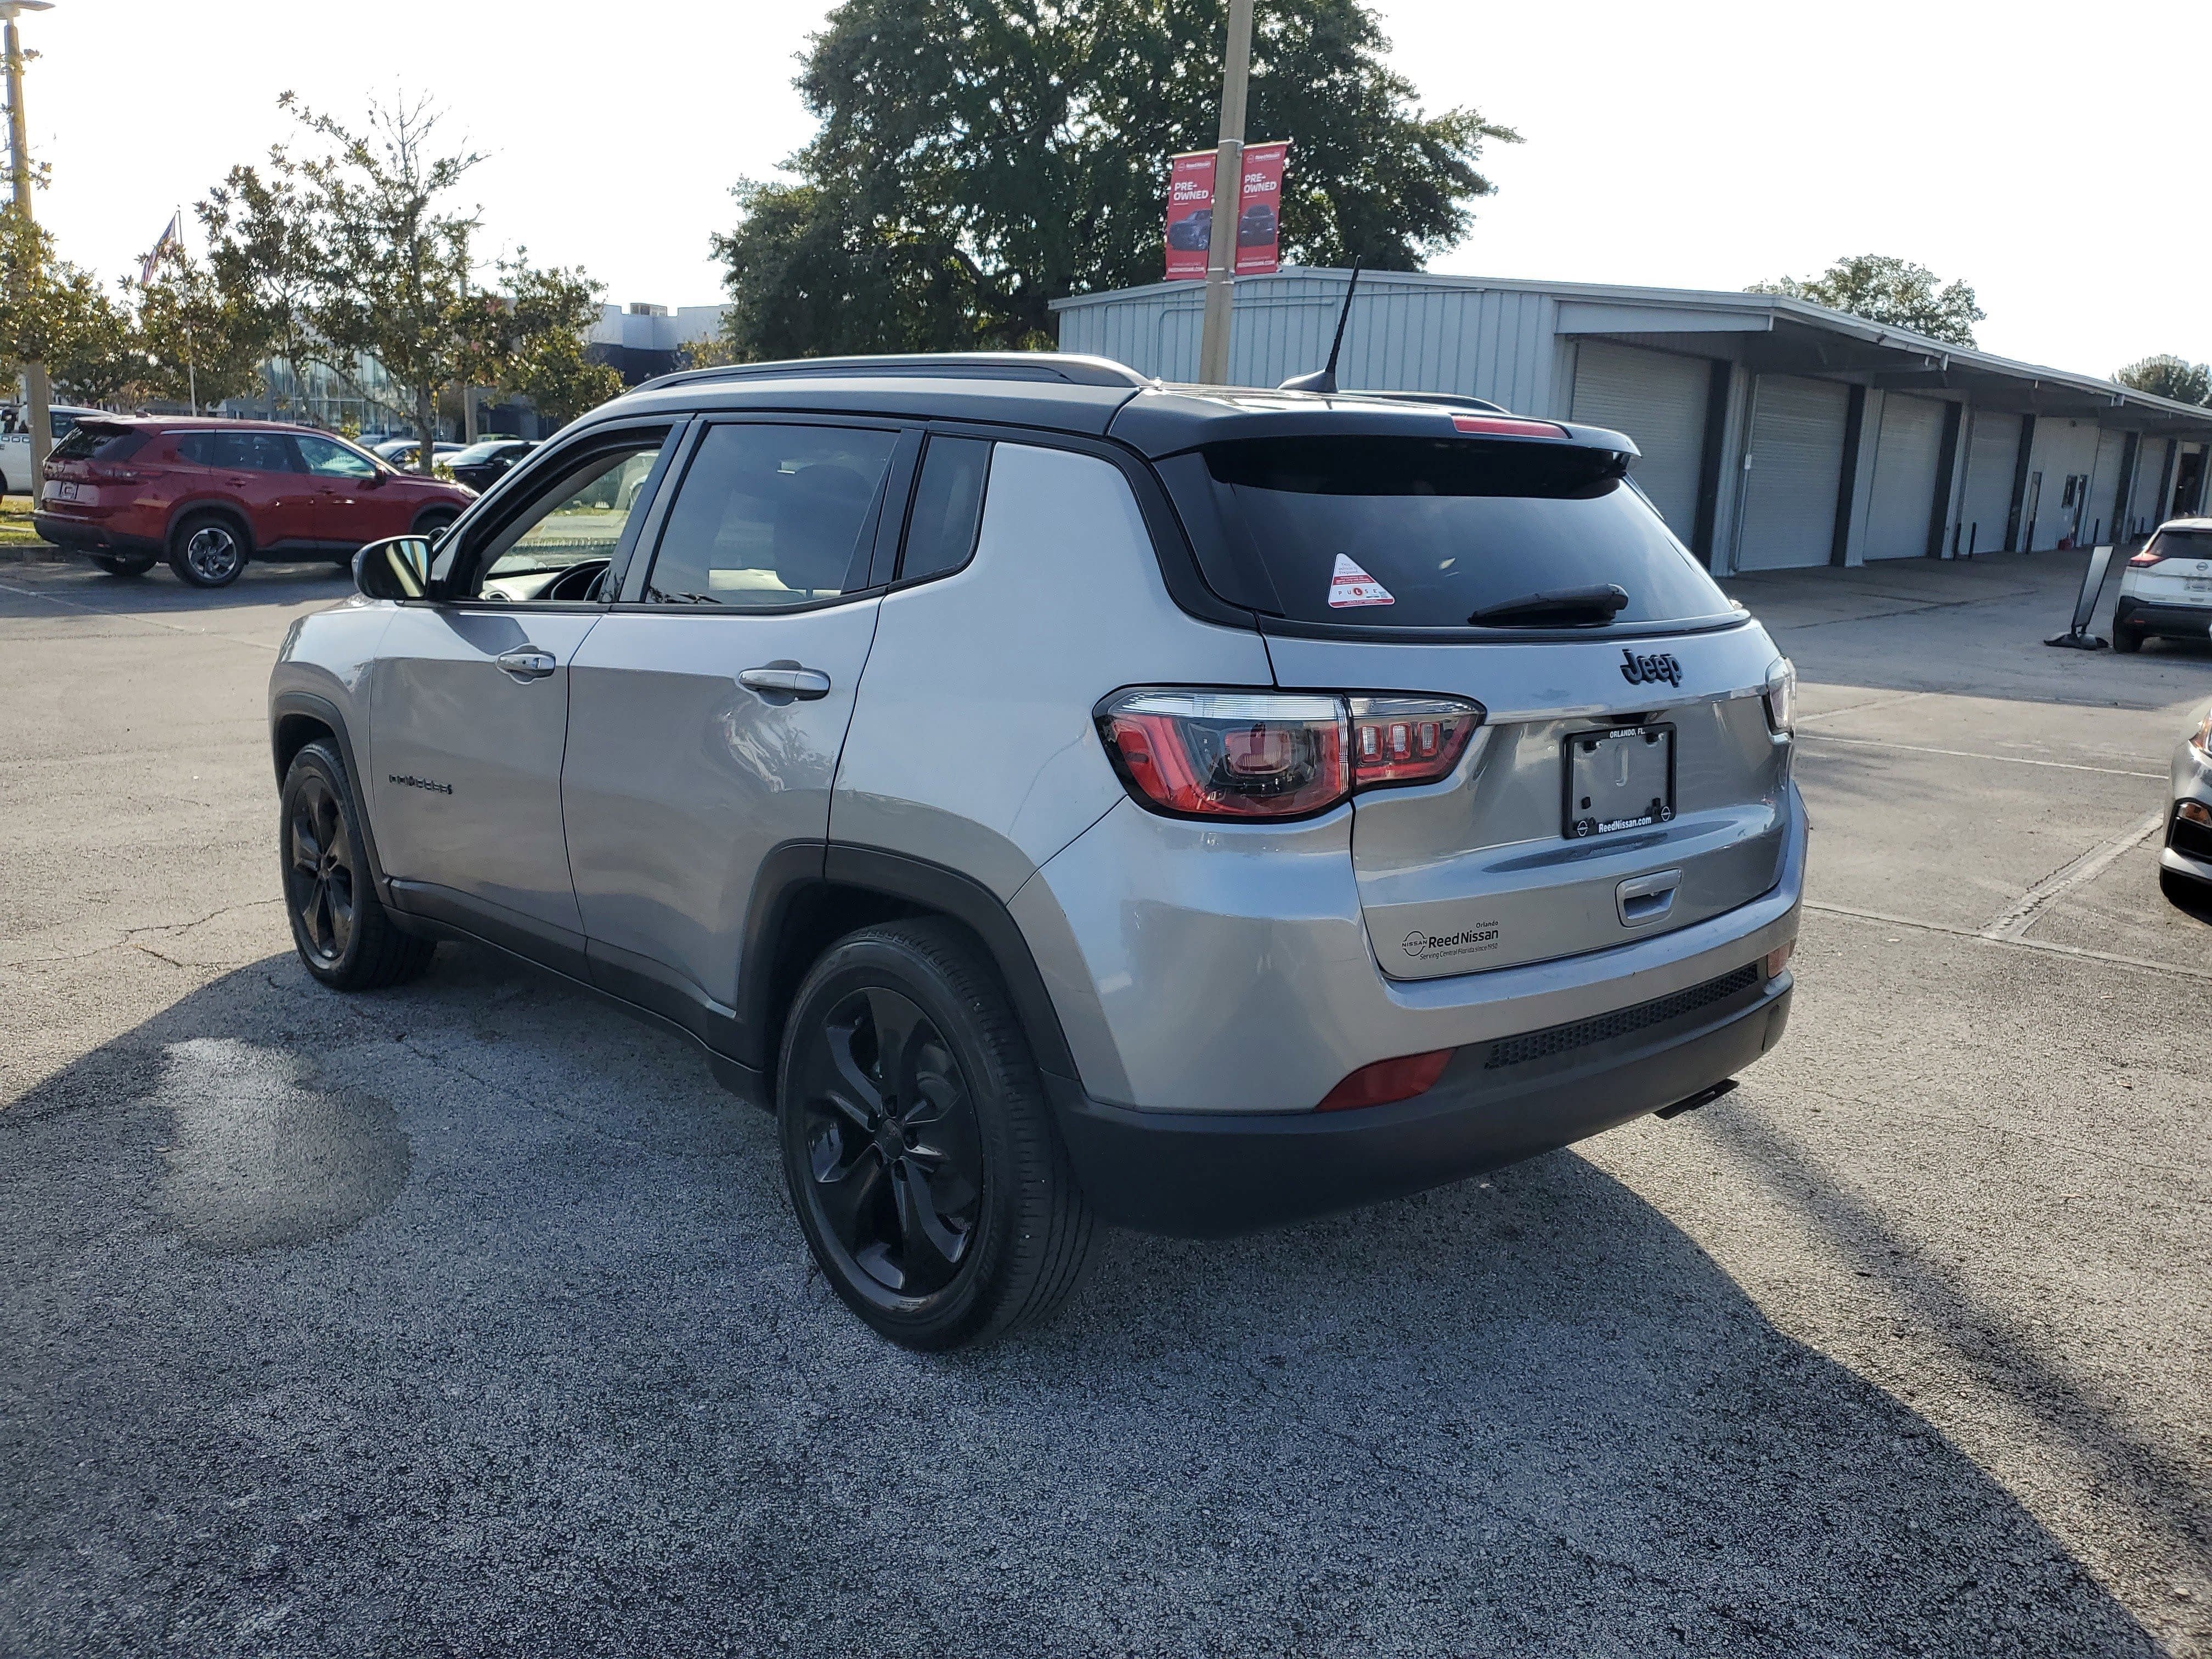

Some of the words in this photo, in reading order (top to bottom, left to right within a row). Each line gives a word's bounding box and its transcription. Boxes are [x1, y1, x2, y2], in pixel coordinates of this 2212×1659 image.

[1244, 173, 1266, 183] PRE-
[1175, 182, 1197, 191] PRE-
[1244, 182, 1277, 193] OWNED
[1173, 190, 1209, 200] OWNED
[1620, 648, 1684, 688] Jeep
[1609, 729, 1637, 739] ORLANDO,
[1598, 816, 1652, 834] ReedNissan.com
[1476, 920, 1498, 928] Orlando
[1440, 949, 1458, 957] Central
[1458, 946, 1475, 955] Florida
